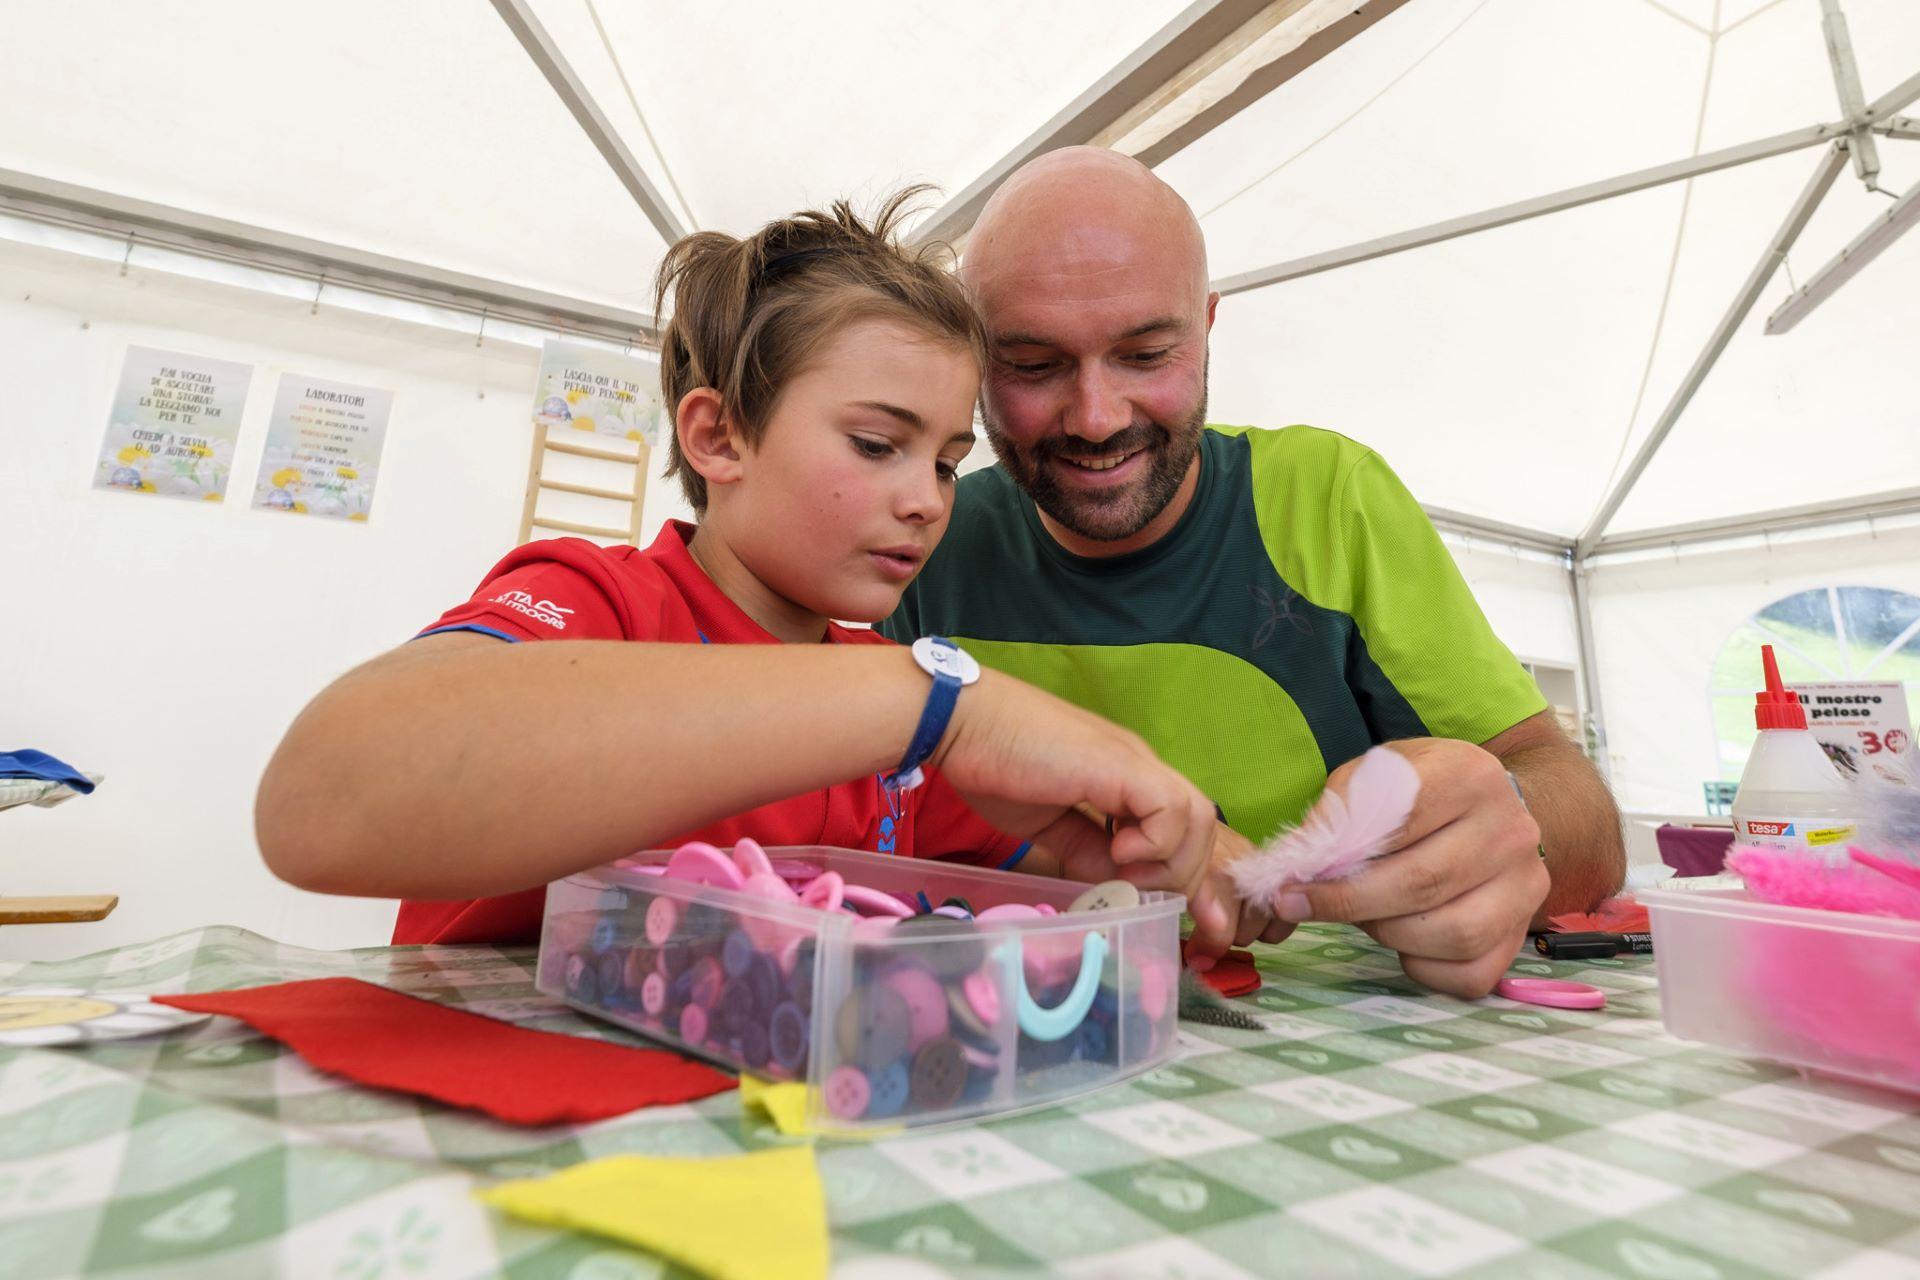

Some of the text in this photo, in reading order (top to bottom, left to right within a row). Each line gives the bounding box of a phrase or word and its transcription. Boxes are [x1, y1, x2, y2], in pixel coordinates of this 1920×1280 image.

[181, 370, 211, 383] VOGLIA
[564, 369, 640, 393] LASCIA QUI IL TUO
[153, 387, 172, 399] UNA
[165, 379, 215, 394] ASCOLTARE
[564, 380, 637, 404] PETALO PENSIERO
[305, 388, 365, 407] LABORATORI
[139, 396, 221, 417] LA LEGGIAMO NOI
[159, 410, 177, 421] PER
[132, 429, 164, 442] CHIEDI
[180, 436, 207, 449] SILVIA
[135, 442, 143, 452] O
[1816, 694, 1882, 705] mostro
[1811, 707, 1871, 719] peloso
[1749, 822, 1779, 835] tesa
